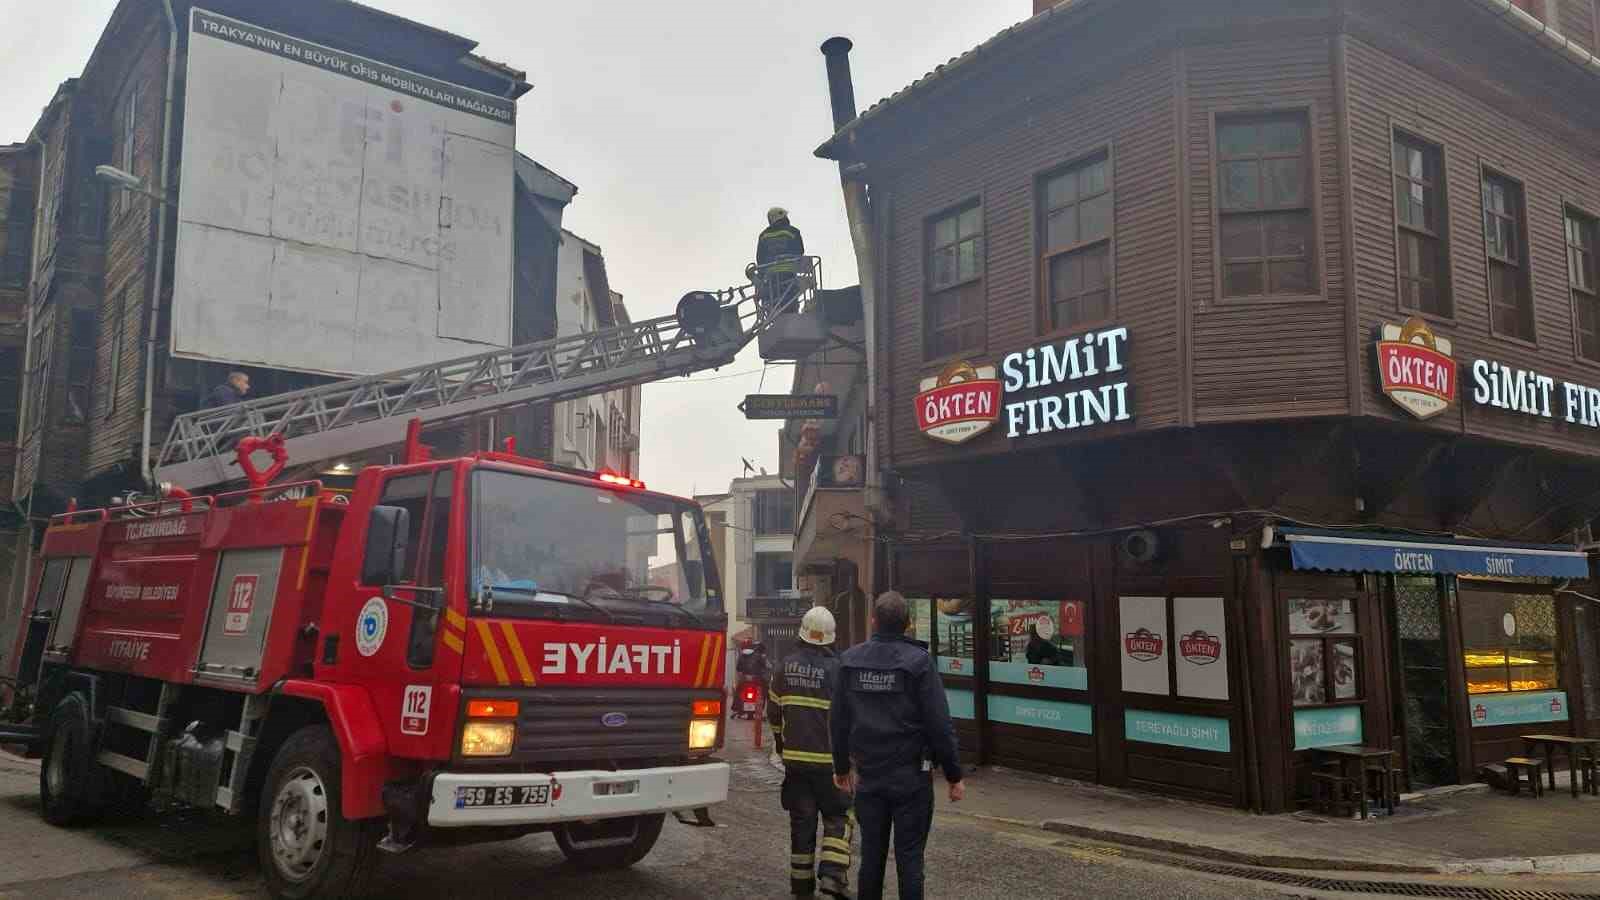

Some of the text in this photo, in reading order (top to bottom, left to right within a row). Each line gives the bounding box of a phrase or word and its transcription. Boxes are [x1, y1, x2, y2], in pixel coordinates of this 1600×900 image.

[200, 18, 281, 50] TRAKYA'NIN
[283, 43, 301, 57] EN
[304, 49, 347, 71] BÜYÜK
[1388, 349, 1448, 393] ÖKTEN
[925, 391, 992, 424] ÖKTEN
[1004, 382, 1131, 438] FIRINI
[1393, 549, 1433, 571] ÖKTEN
[232, 582, 252, 609] 112
[784, 661, 825, 679] itfaiye
[407, 690, 427, 714] 112
[464, 788, 486, 805] 59
[493, 787, 513, 805] ES
[520, 786, 548, 804] 755
